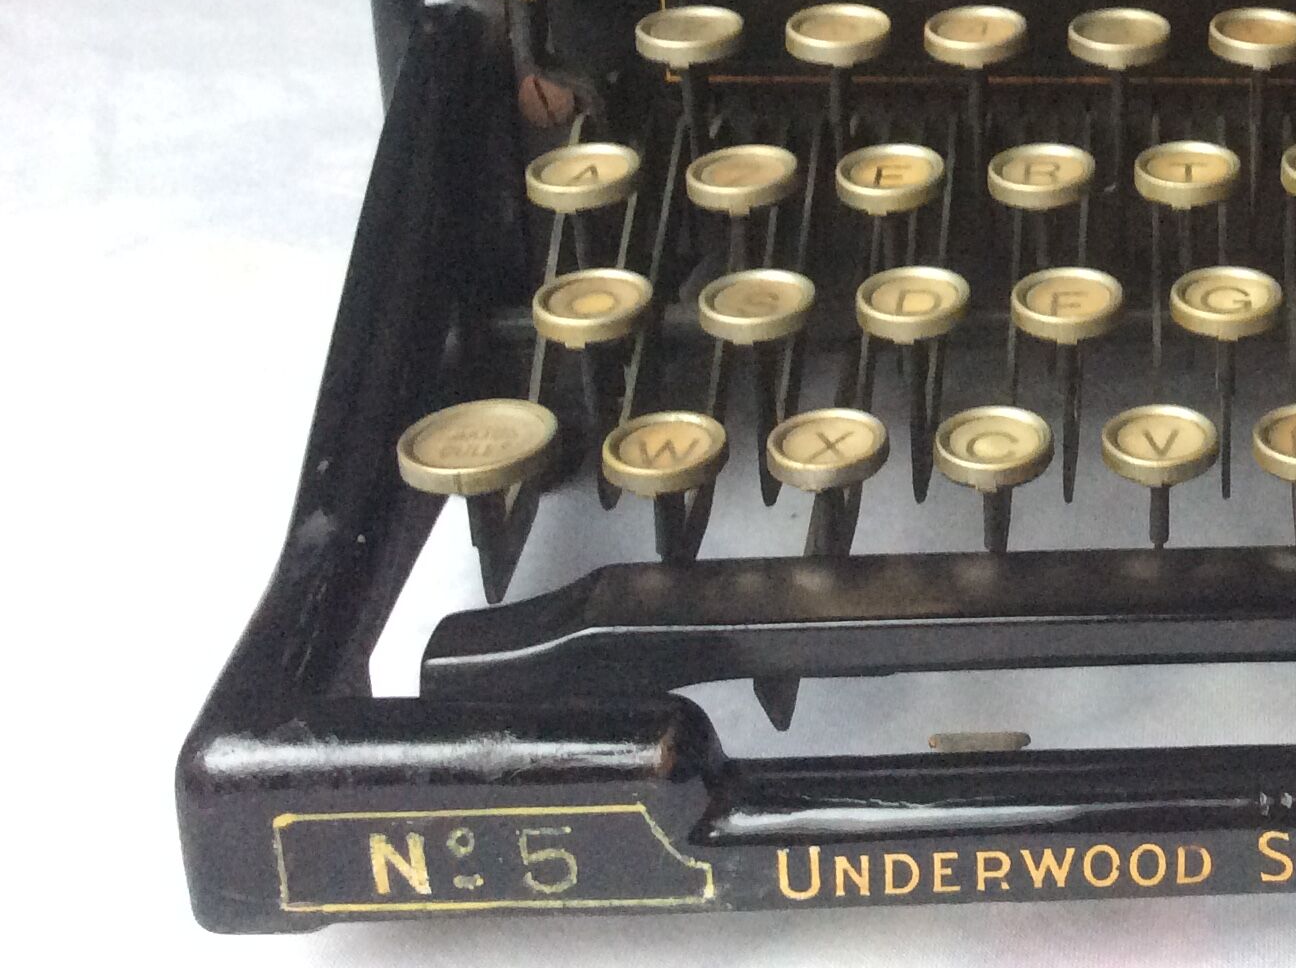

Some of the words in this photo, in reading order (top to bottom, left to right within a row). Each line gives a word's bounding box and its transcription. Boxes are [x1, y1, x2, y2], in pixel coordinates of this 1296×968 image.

[873, 163, 904, 186] E
[1023, 160, 1061, 185] R
[1169, 161, 1208, 184] T
[896, 289, 942, 317] D
[1200, 286, 1253, 314] G
[638, 437, 701, 468] W
[807, 430, 855, 461] X
[964, 431, 1018, 461] C
[1142, 428, 1180, 458] V
[515, 825, 578, 894] 5
[776, 843, 1213, 901] UNDERWOOD
